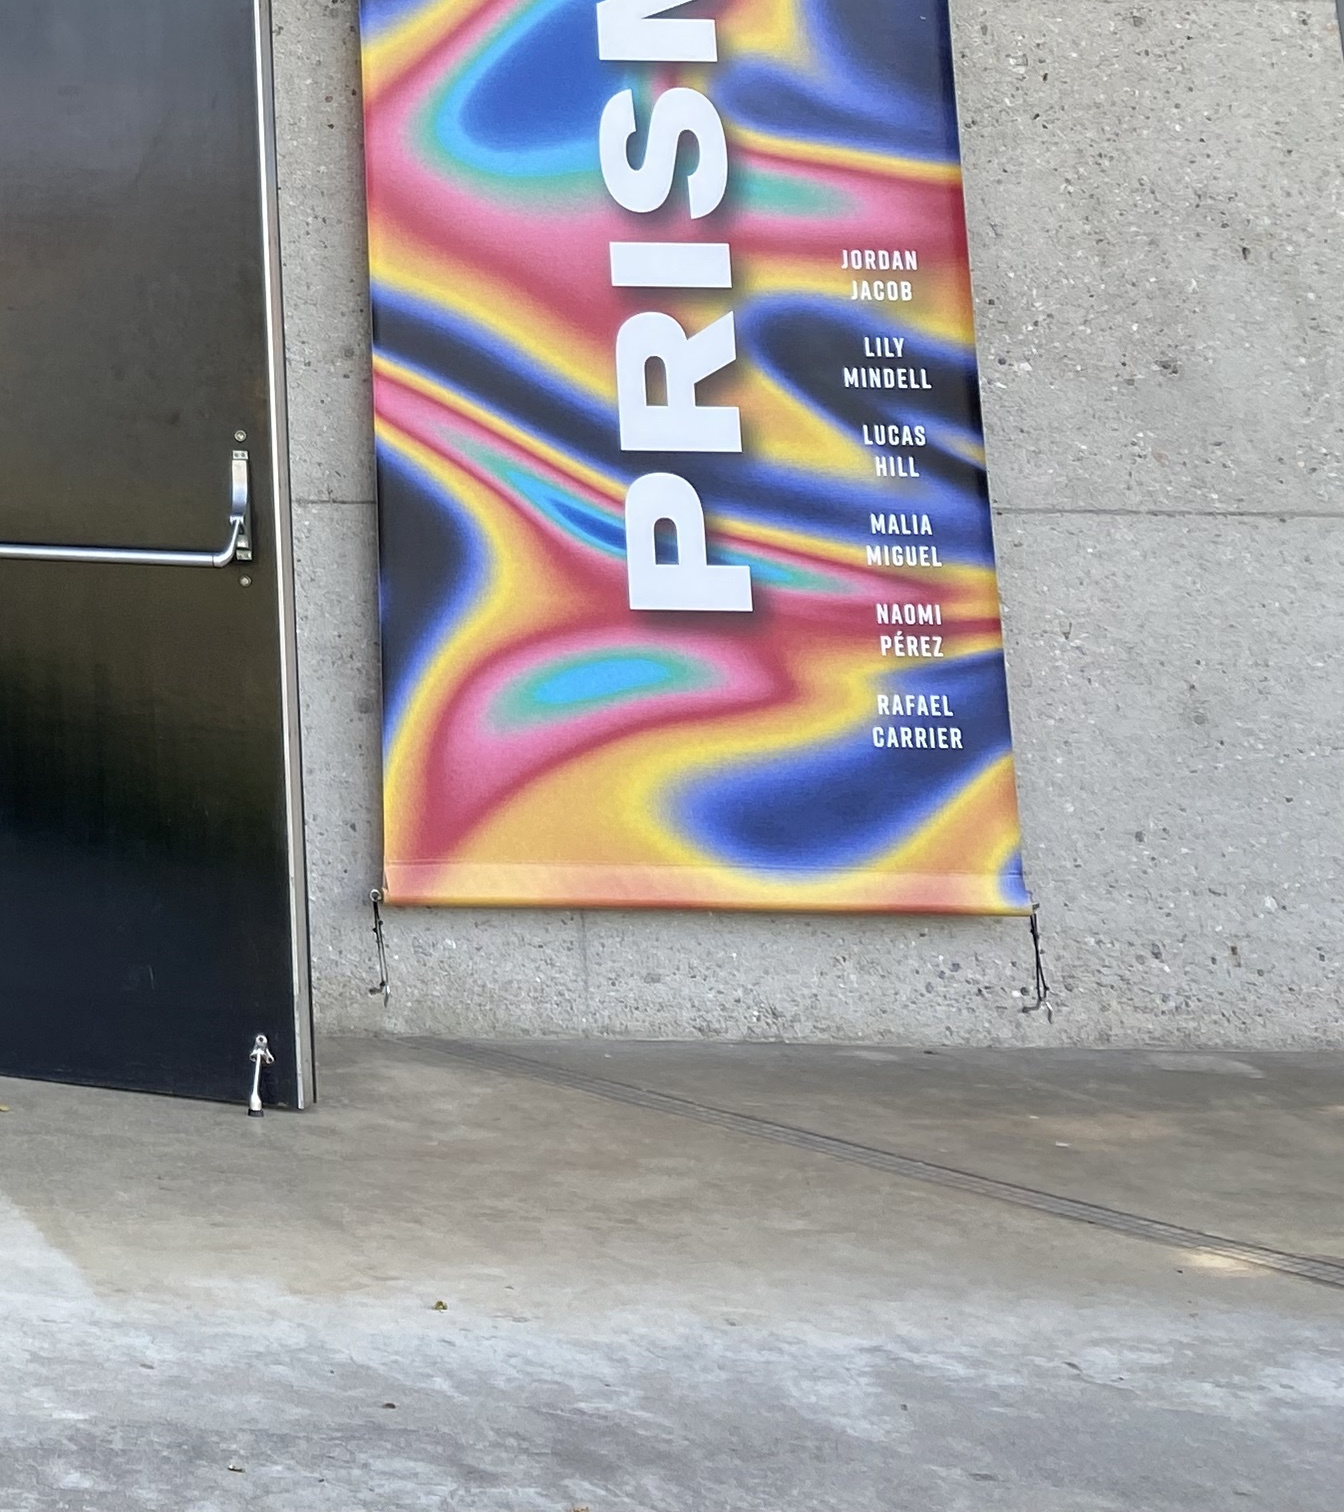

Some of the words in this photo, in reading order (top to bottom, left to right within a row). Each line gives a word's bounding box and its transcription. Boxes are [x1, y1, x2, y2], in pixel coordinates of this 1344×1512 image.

[841, 249, 918, 270] JORDAN
[851, 281, 911, 301] JACOB
[864, 337, 904, 358] LILY
[844, 368, 932, 389] MINDELL
[863, 425, 925, 446] LUCAS
[875, 456, 919, 477] HILL
[870, 514, 932, 535] MALIA
[866, 546, 942, 567] MIGUEL
[876, 603, 942, 625] NAOMI
[880, 630, 943, 657] PÉREZ
[877, 695, 953, 716] RAFAEL
[873, 727, 963, 749] CARRIER
